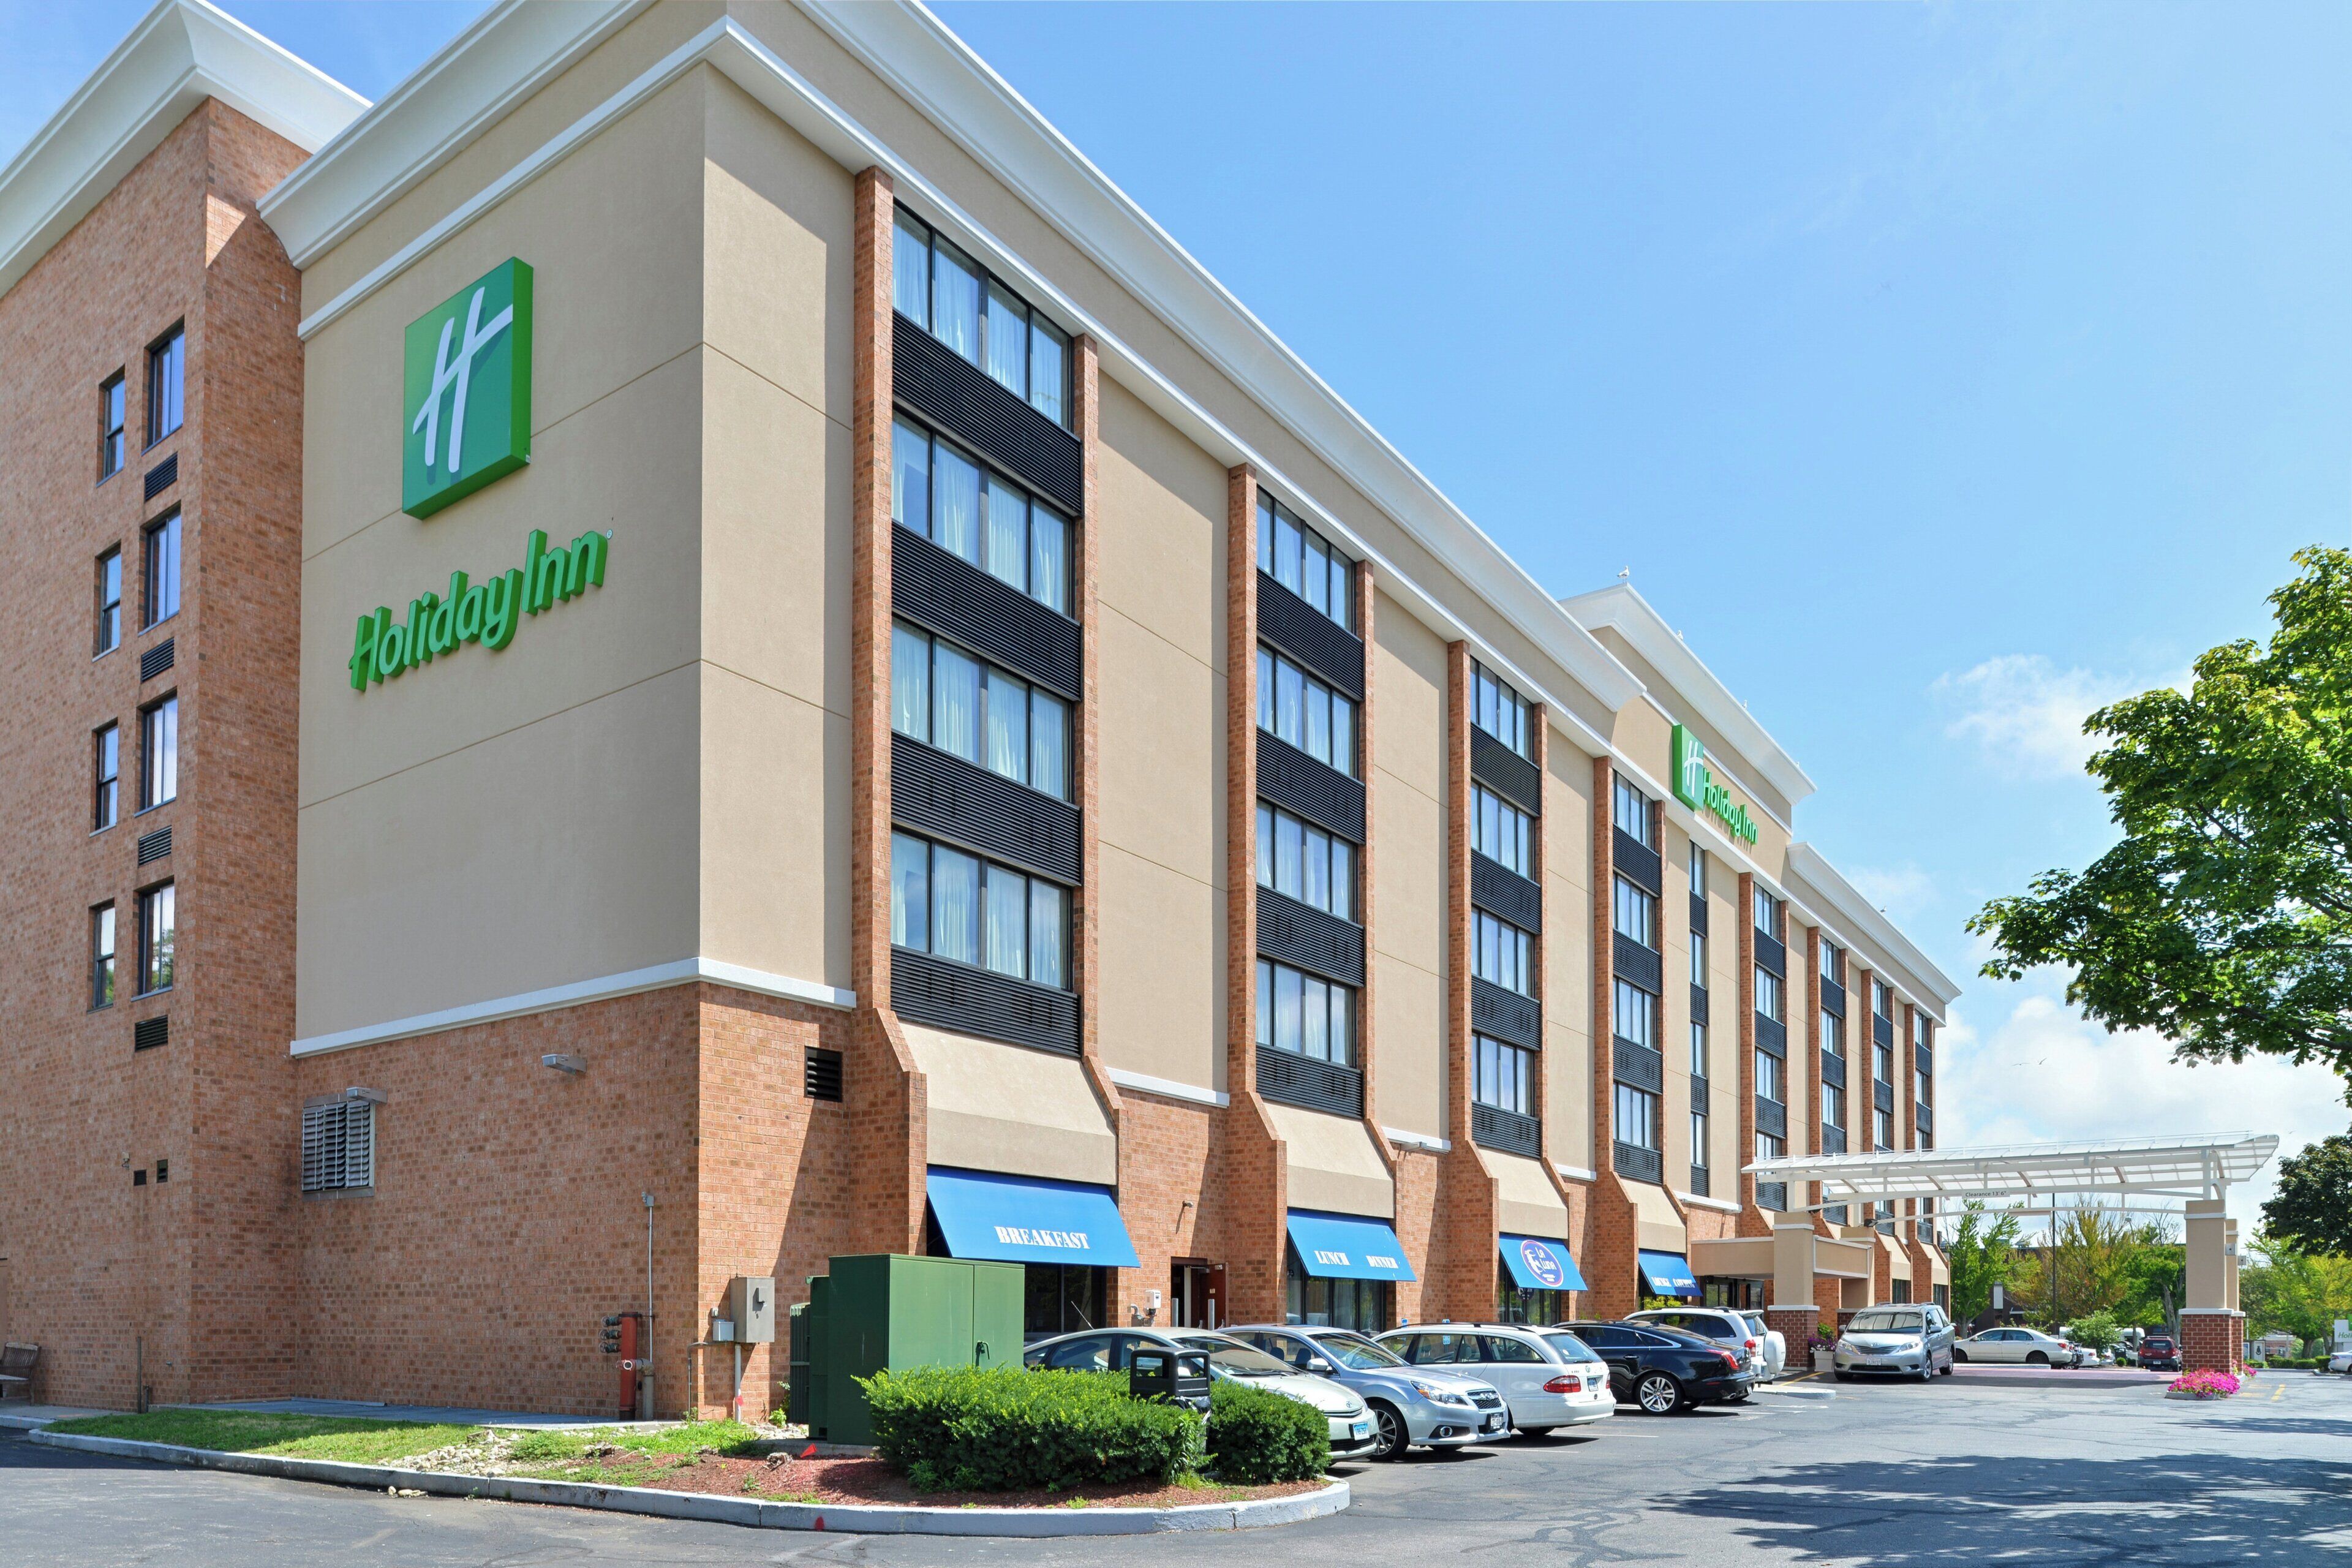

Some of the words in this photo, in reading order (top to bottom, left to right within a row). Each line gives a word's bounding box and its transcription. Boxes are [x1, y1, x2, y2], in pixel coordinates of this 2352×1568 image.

[349, 568, 524, 692] Holiday
[521, 529, 608, 616] Inn
[1703, 767, 1742, 837] Holiday
[1741, 804, 1758, 845] Inn
[993, 1226, 1090, 1250] BREAKFAST
[1313, 1250, 1351, 1266] LUNCH
[1365, 1255, 1400, 1269] DINNER
